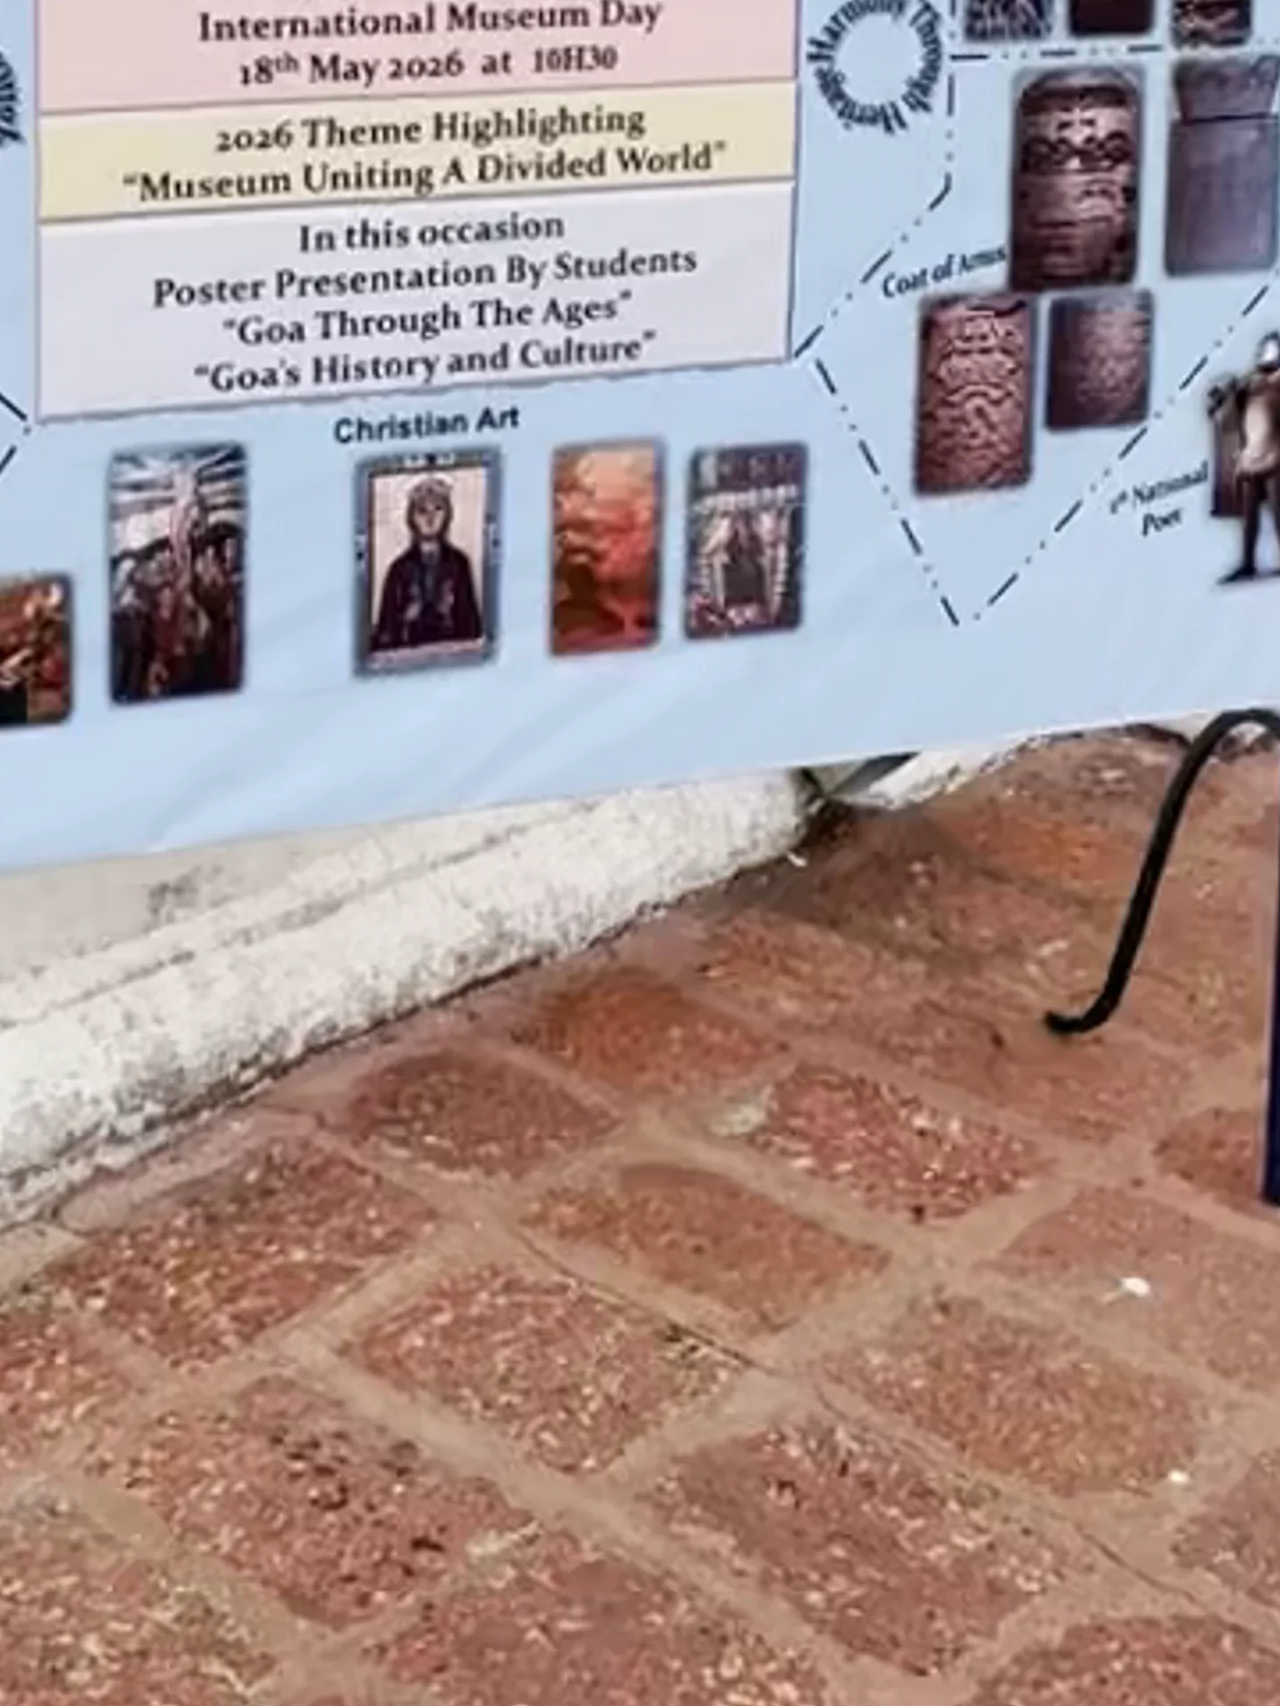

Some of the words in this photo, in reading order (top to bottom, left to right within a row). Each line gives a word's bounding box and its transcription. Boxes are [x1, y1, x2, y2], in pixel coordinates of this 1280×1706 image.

[199, 4, 435, 41] International
[447, 2, 590, 32] Museum
[240, 52, 300, 86] 18th
[310, 53, 379, 87] May
[388, 49, 465, 80] 2026
[481, 51, 512, 75] at
[533, 45, 618, 73] 10H30
[815, 67, 908, 134] Heritage
[216, 119, 293, 152] 2026
[301, 117, 422, 148] Theme
[434, 105, 646, 147] Highlighting
[123, 171, 291, 202] "Museum
[304, 159, 435, 195] Uniting
[442, 156, 467, 184] A
[478, 148, 607, 182] Divided
[617, 140, 726, 173] World"
[299, 225, 336, 252] In
[346, 218, 410, 248] this
[418, 211, 565, 246] occasion
[154, 278, 266, 307] Poster
[276, 260, 496, 299] Presentation
[506, 254, 547, 289] By
[553, 247, 698, 280] Students
[223, 314, 305, 345] "Goa
[315, 302, 461, 342] Through
[470, 298, 534, 328] The
[542, 290, 632, 329] Ages"
[194, 358, 301, 392] "Goa's
[312, 353, 440, 384] History
[447, 342, 509, 373] and
[520, 329, 656, 368] Culture"
[335, 410, 468, 443] Christian
[475, 405, 520, 433] Art
